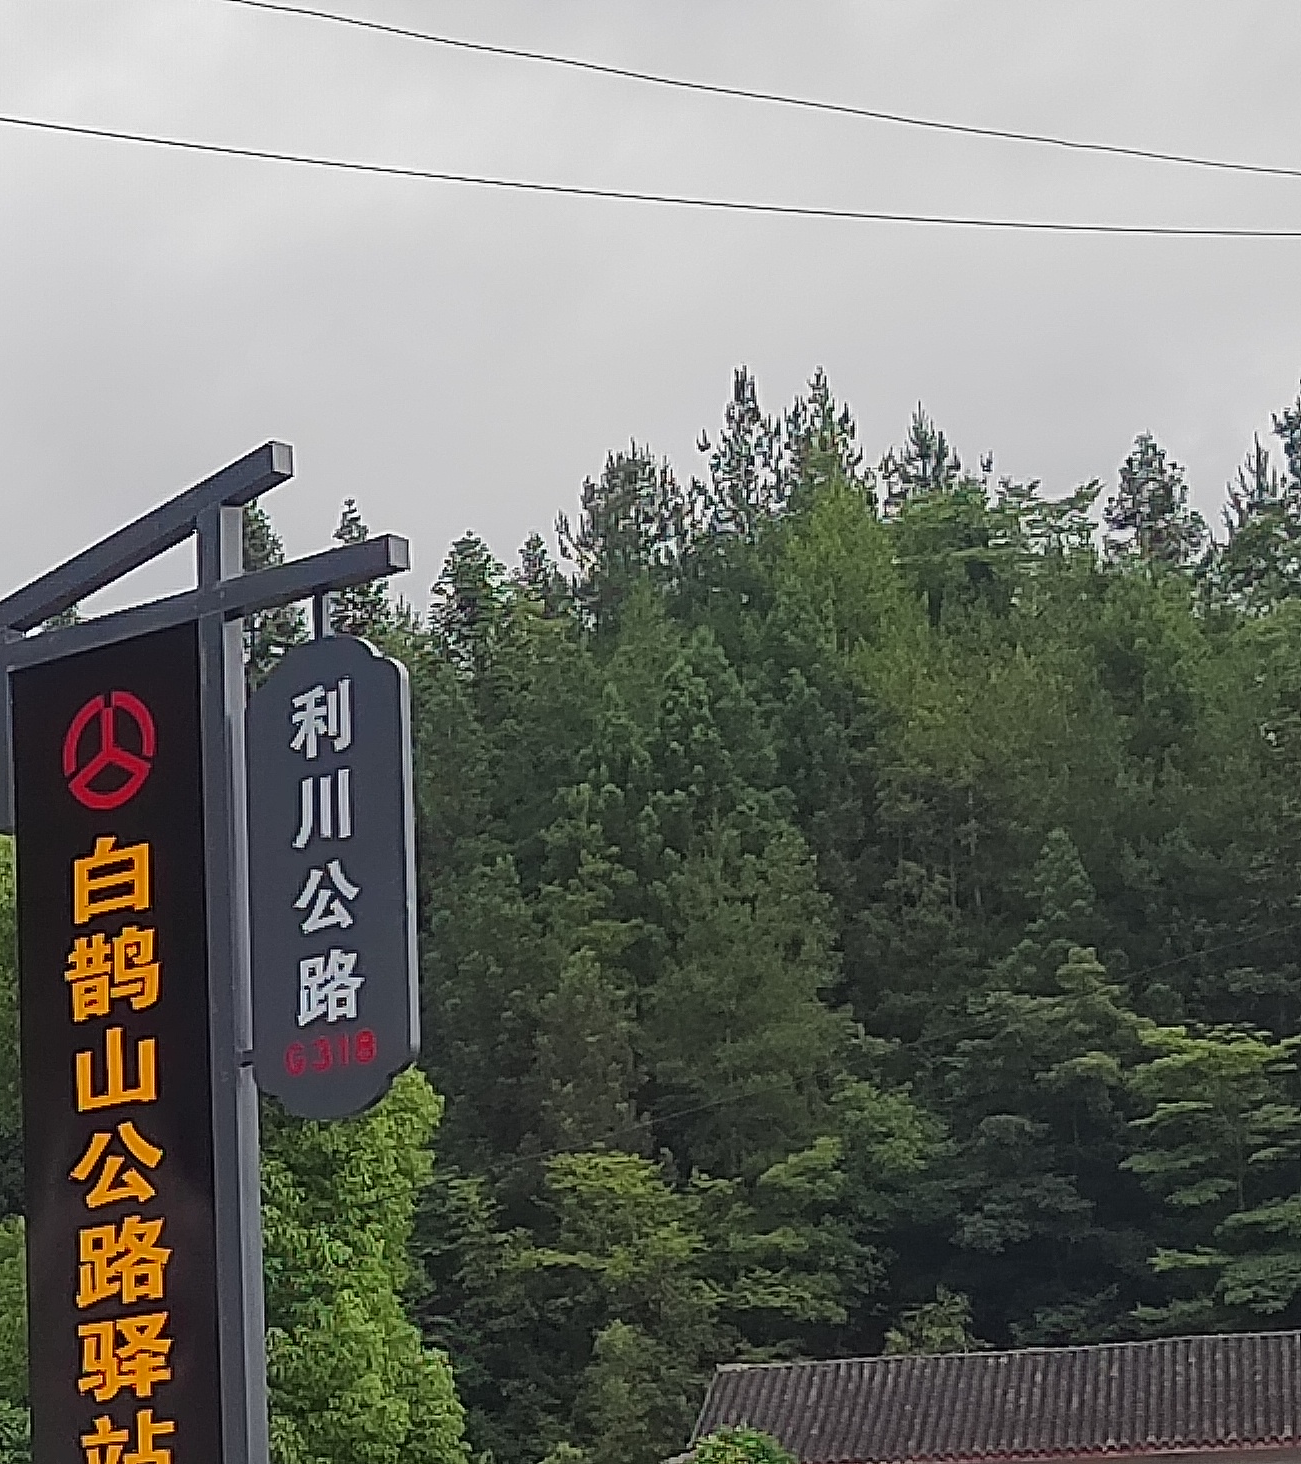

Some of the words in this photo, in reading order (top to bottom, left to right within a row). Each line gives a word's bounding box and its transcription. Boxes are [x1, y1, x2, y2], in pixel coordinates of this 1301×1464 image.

[289, 677, 365, 1027] 利川公路
[284, 1029, 378, 1077] G318
